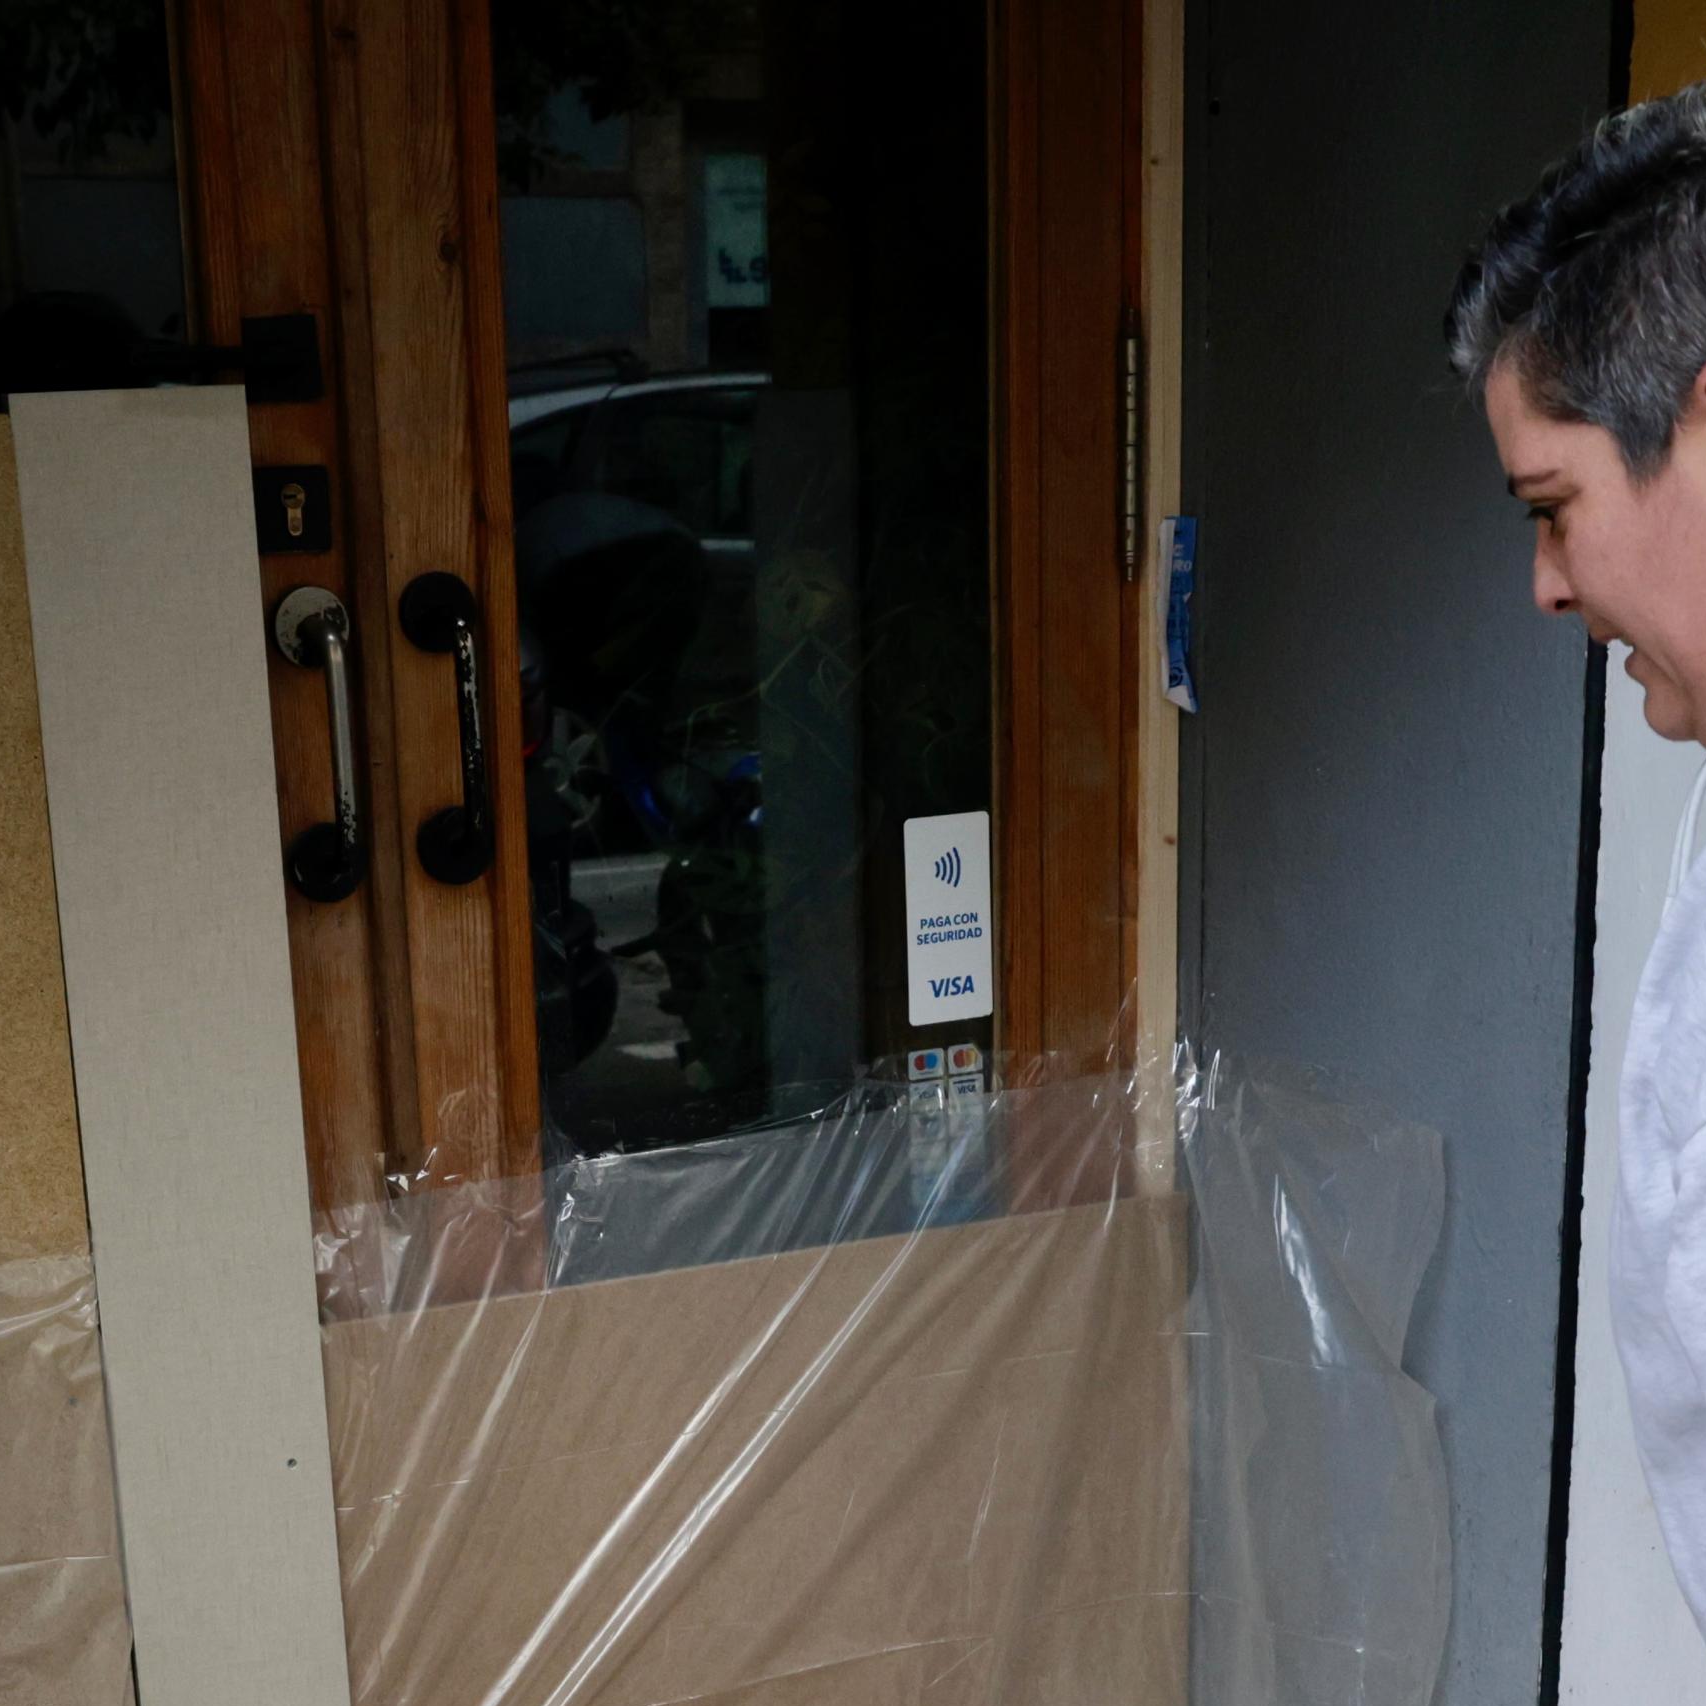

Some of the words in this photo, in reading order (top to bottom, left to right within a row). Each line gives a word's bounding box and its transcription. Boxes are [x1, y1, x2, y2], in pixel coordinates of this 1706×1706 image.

[920, 915, 952, 930] PAGA
[953, 912, 978, 925] CON
[917, 927, 982, 945] SEGURIDAD
[927, 974, 975, 998] VISA
